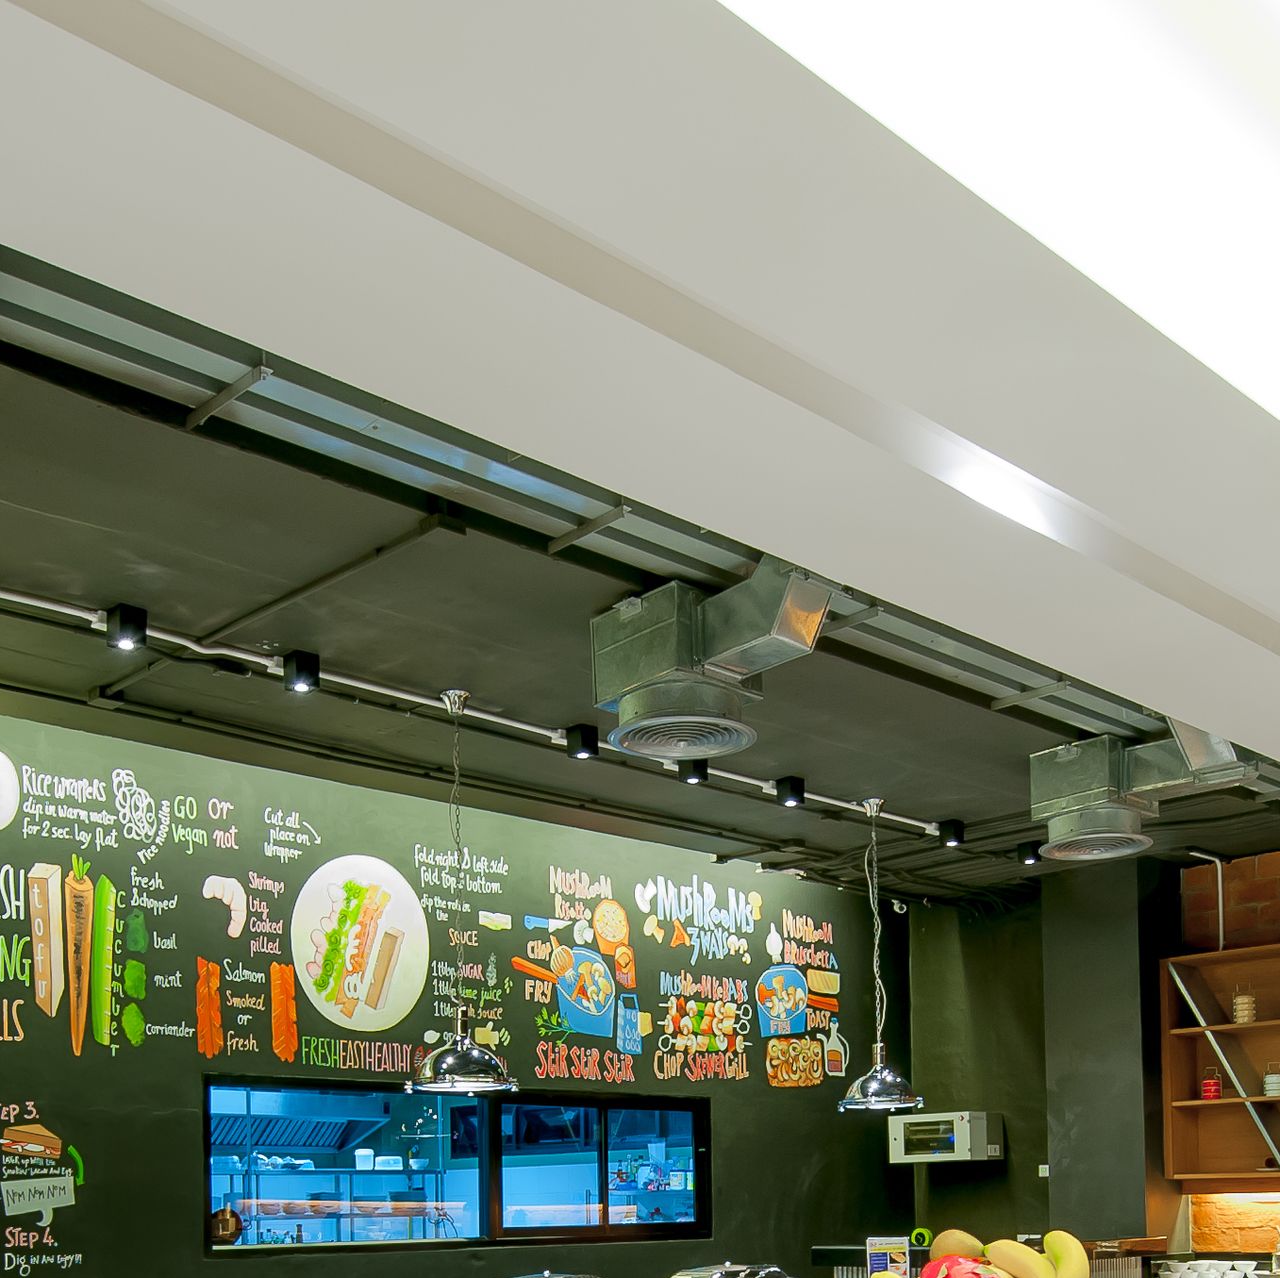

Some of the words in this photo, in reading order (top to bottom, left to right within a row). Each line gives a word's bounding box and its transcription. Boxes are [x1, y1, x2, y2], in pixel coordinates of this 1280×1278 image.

[22, 765, 51, 798] Rice
[173, 794, 198, 820] GO
[264, 807, 284, 826] Cut
[285, 814, 301, 829] all
[22, 820, 38, 841] for
[41, 822, 50, 838] 2
[172, 822, 209, 854] Vegan
[212, 825, 239, 849] not
[270, 828, 296, 846] place
[297, 833, 311, 846] on
[130, 866, 165, 891] fresh
[248, 871, 285, 897] Shrimps
[249, 917, 283, 935] Cooked
[250, 938, 281, 957] pilled
[154, 972, 183, 988] mint
[223, 959, 266, 984] Salmon
[226, 990, 266, 1011] Smoked
[237, 1012, 253, 1026] or
[226, 1030, 259, 1053] fresh
[4, 1252, 30, 1277] Dig
